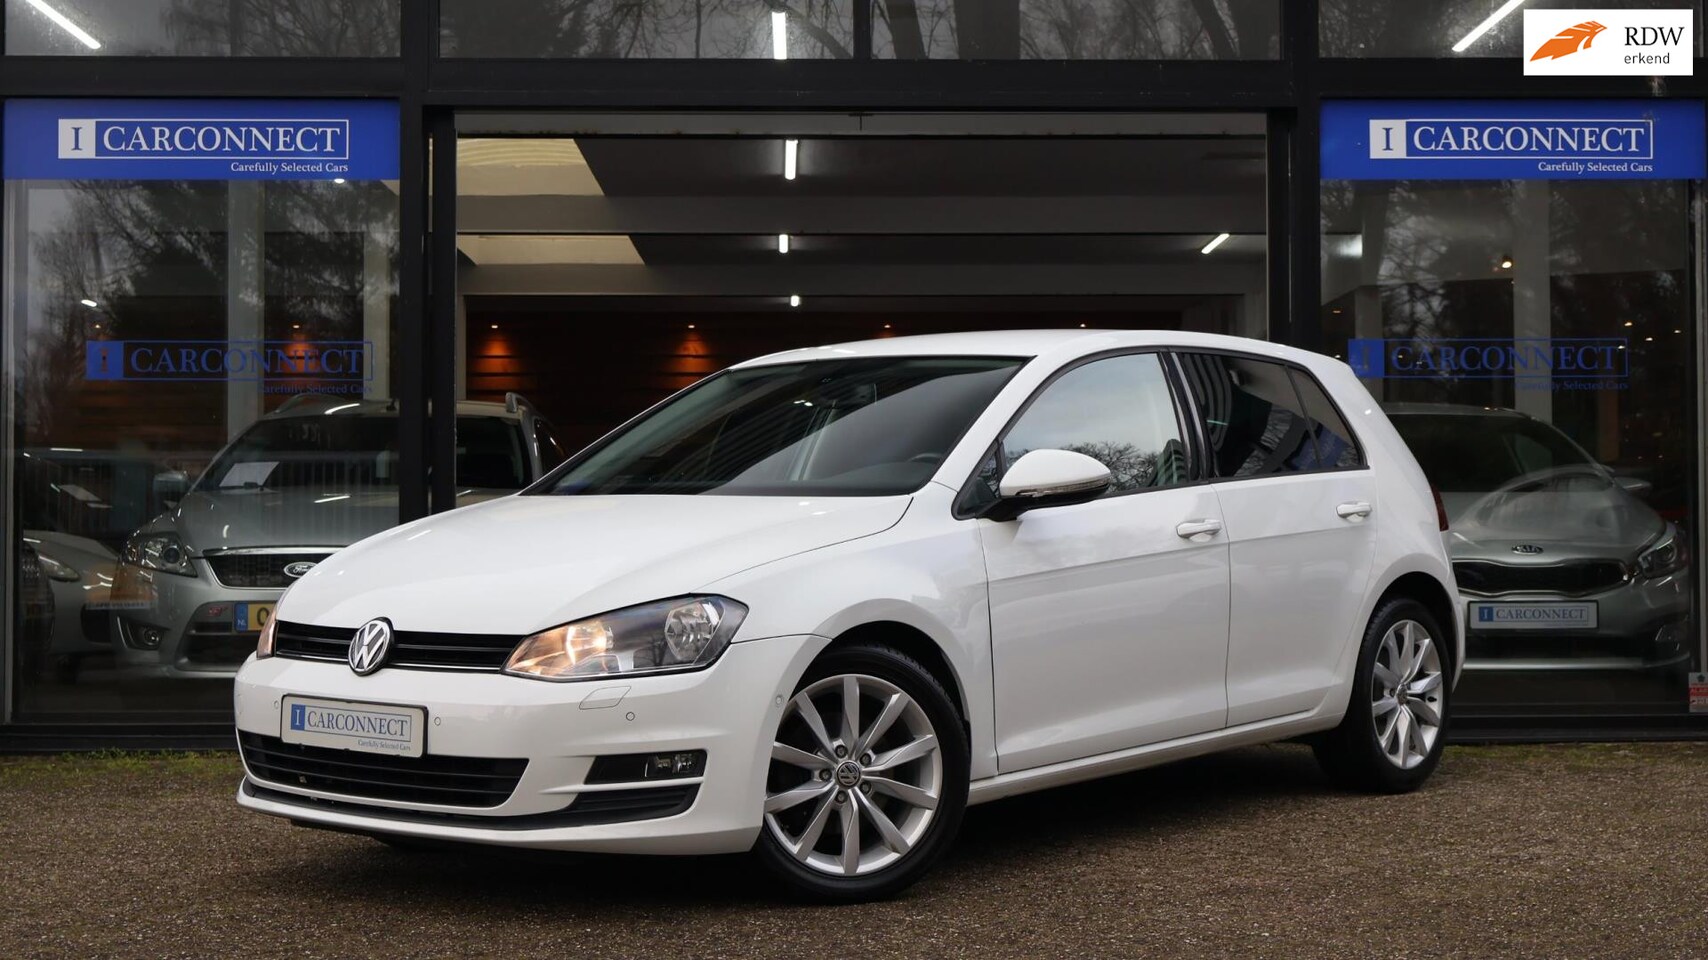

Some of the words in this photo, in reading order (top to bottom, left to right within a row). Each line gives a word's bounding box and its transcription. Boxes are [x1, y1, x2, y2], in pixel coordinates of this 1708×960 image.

[71, 126, 83, 152] I
[103, 125, 341, 152] CARCONNECT
[1382, 127, 1395, 152] I
[1413, 125, 1645, 153] CARCONNECT
[230, 161, 279, 175] Carefully
[280, 162, 323, 173] Selected
[325, 162, 349, 173] Cars
[1538, 161, 1585, 175] Carefully
[1587, 161, 1628, 172] Selected
[1630, 162, 1653, 173] Cars
[129, 346, 366, 374] CARCONNECT
[1391, 345, 1619, 371] CARCONNECT
[1496, 608, 1586, 620] CARCONNECT
[307, 710, 408, 737] CARCONNECT
